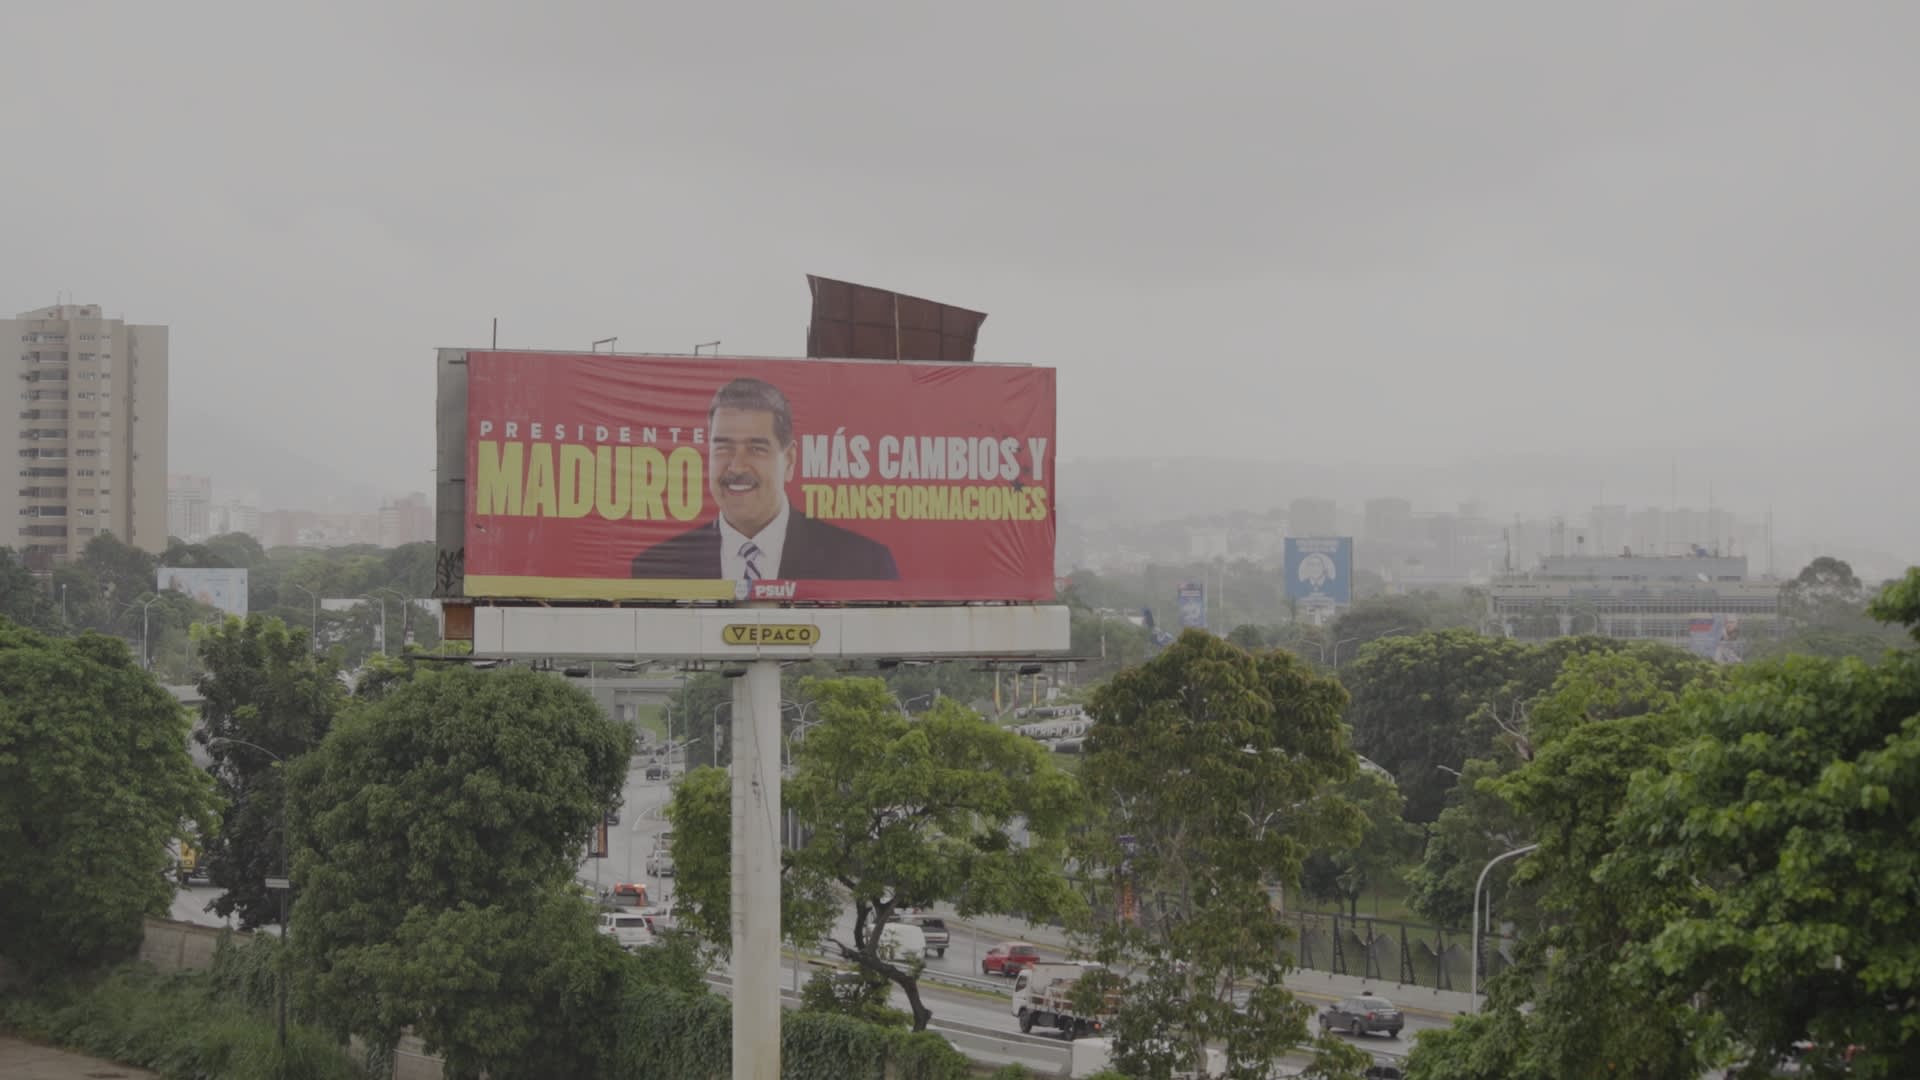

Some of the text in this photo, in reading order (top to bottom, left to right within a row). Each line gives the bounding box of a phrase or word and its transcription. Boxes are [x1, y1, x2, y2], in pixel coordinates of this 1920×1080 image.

[480, 420, 704, 444] PRESIDENTE
[802, 427, 1048, 481] MÁS CAMBIOS Y
[476, 440, 703, 522] MADURO
[802, 484, 1048, 521] TRANSFORMACIONES
[733, 627, 810, 640] VEPACO
